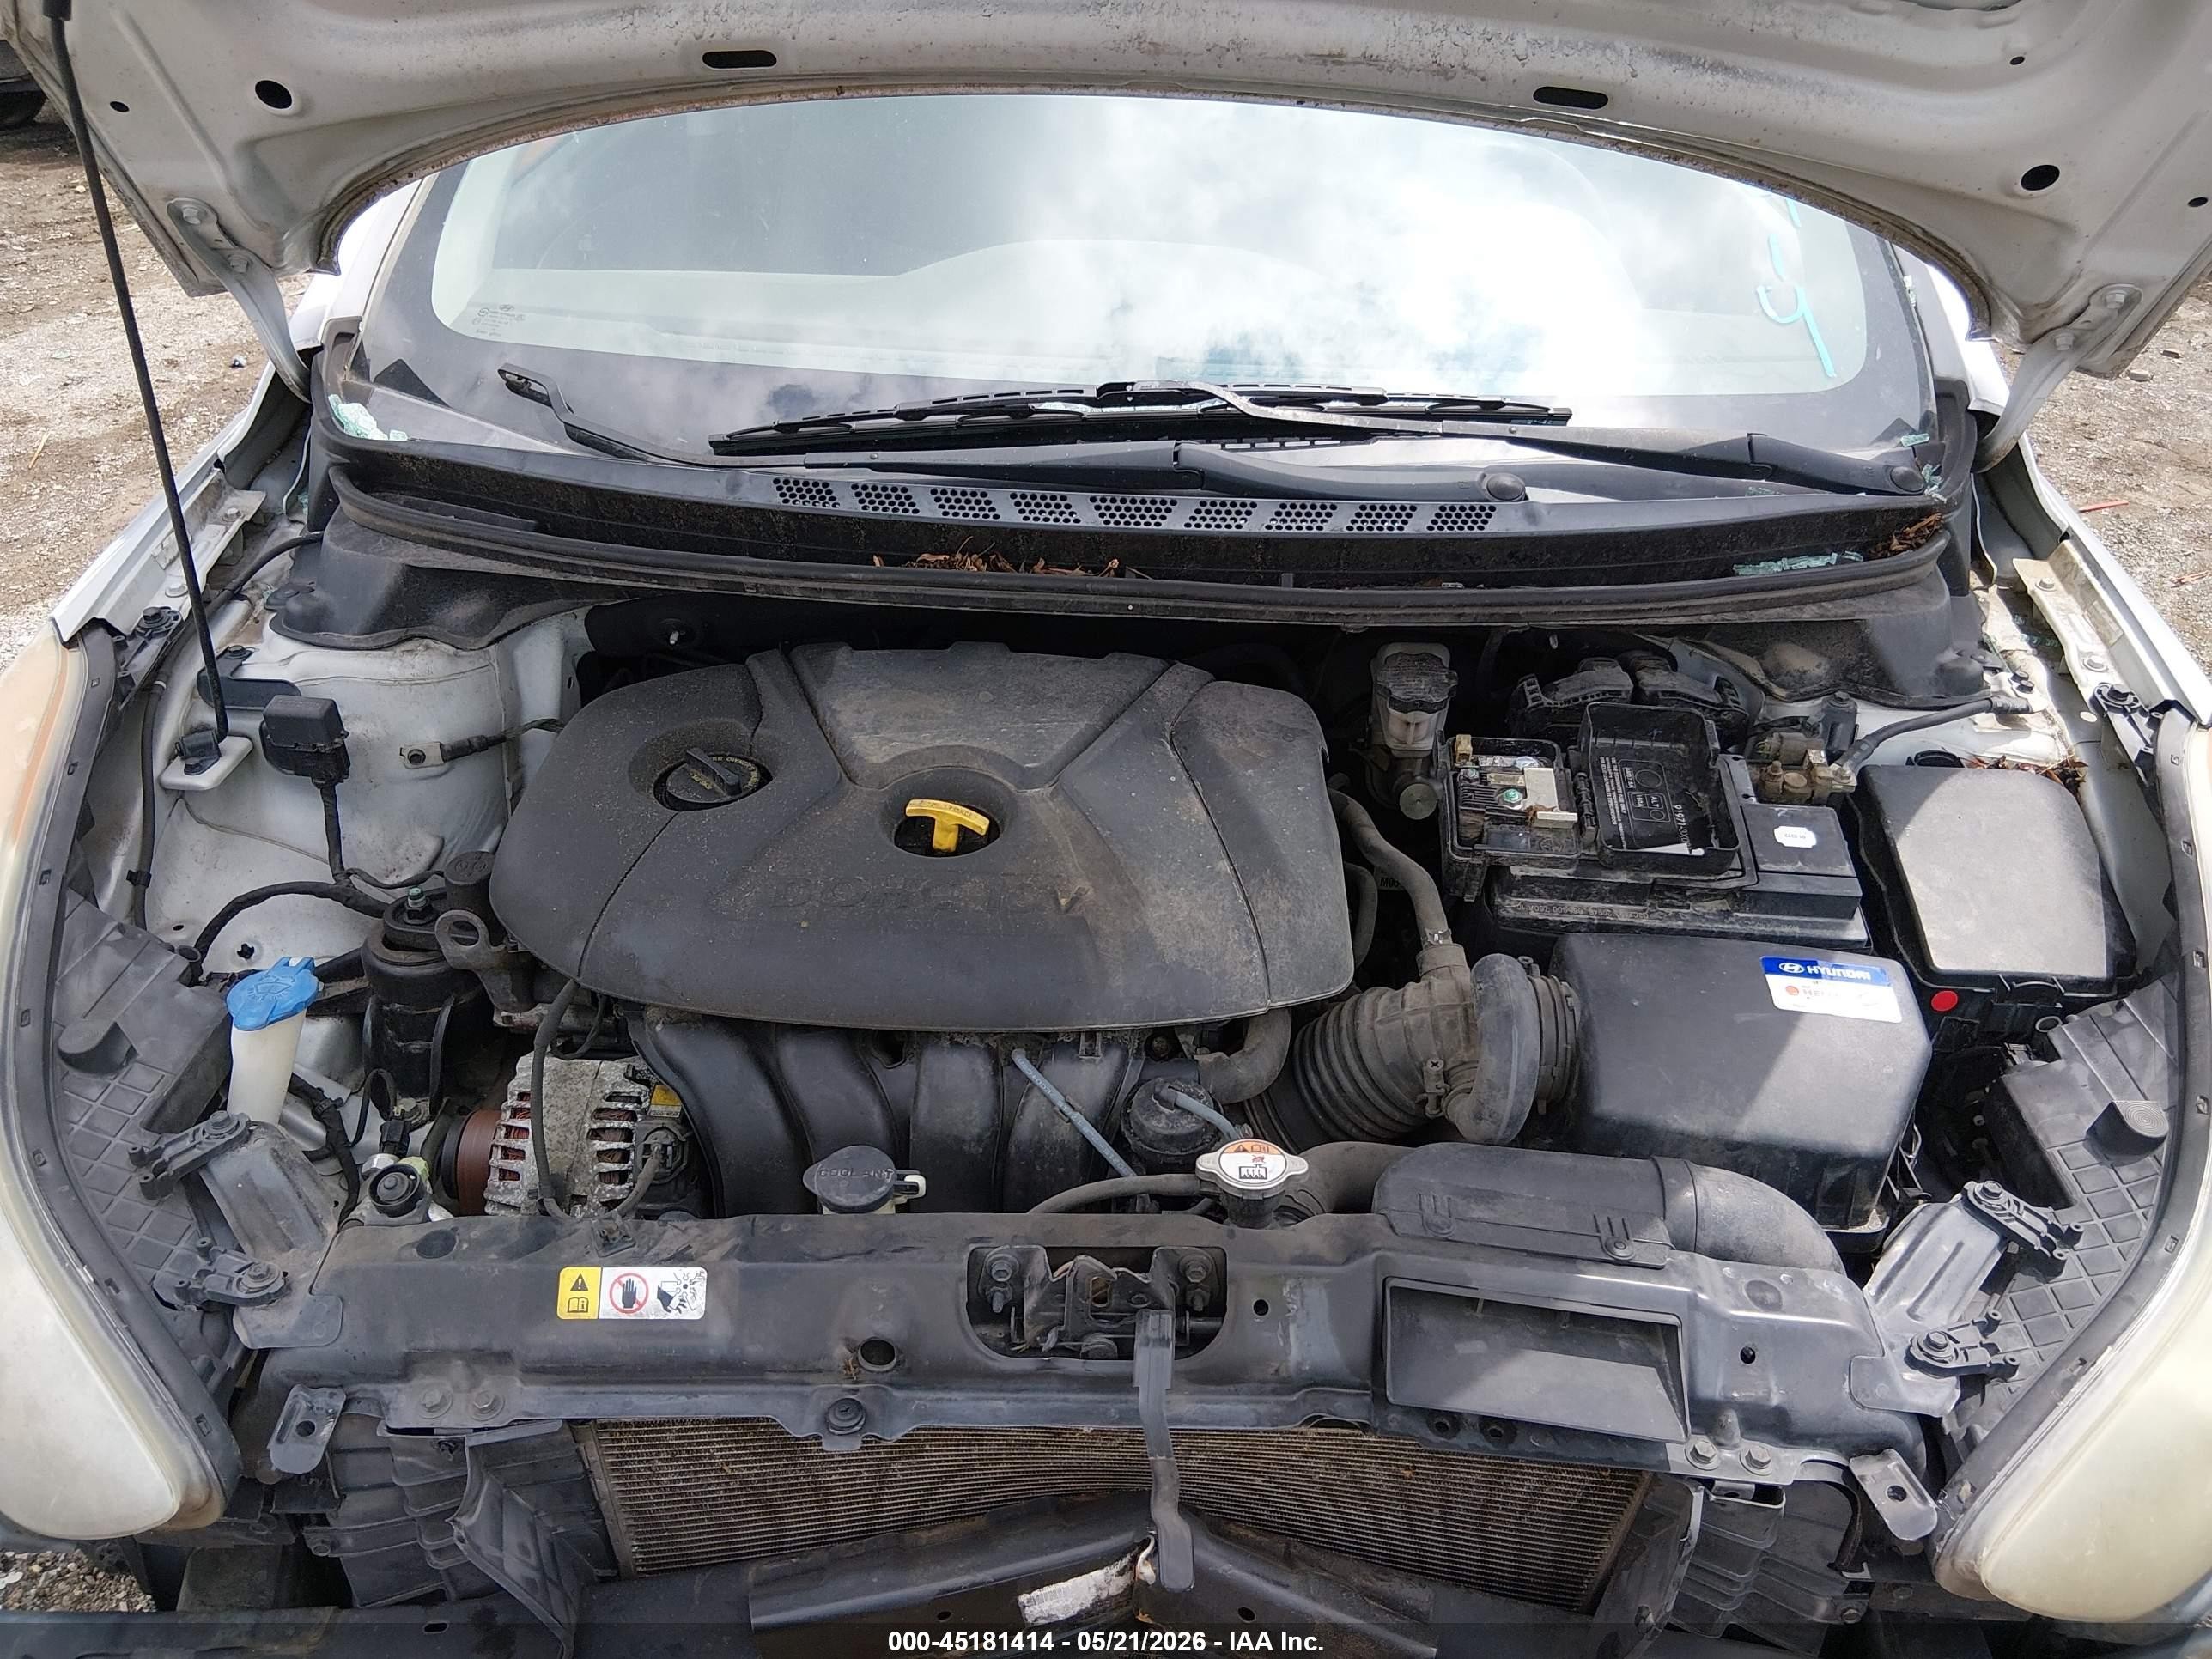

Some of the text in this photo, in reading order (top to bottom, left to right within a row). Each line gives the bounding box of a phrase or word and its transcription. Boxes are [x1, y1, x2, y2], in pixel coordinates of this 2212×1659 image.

[1651, 796, 1660, 808] ALT
[1808, 966, 1871, 981] HYUNDAI
[818, 1168, 895, 1183] COOLANT
